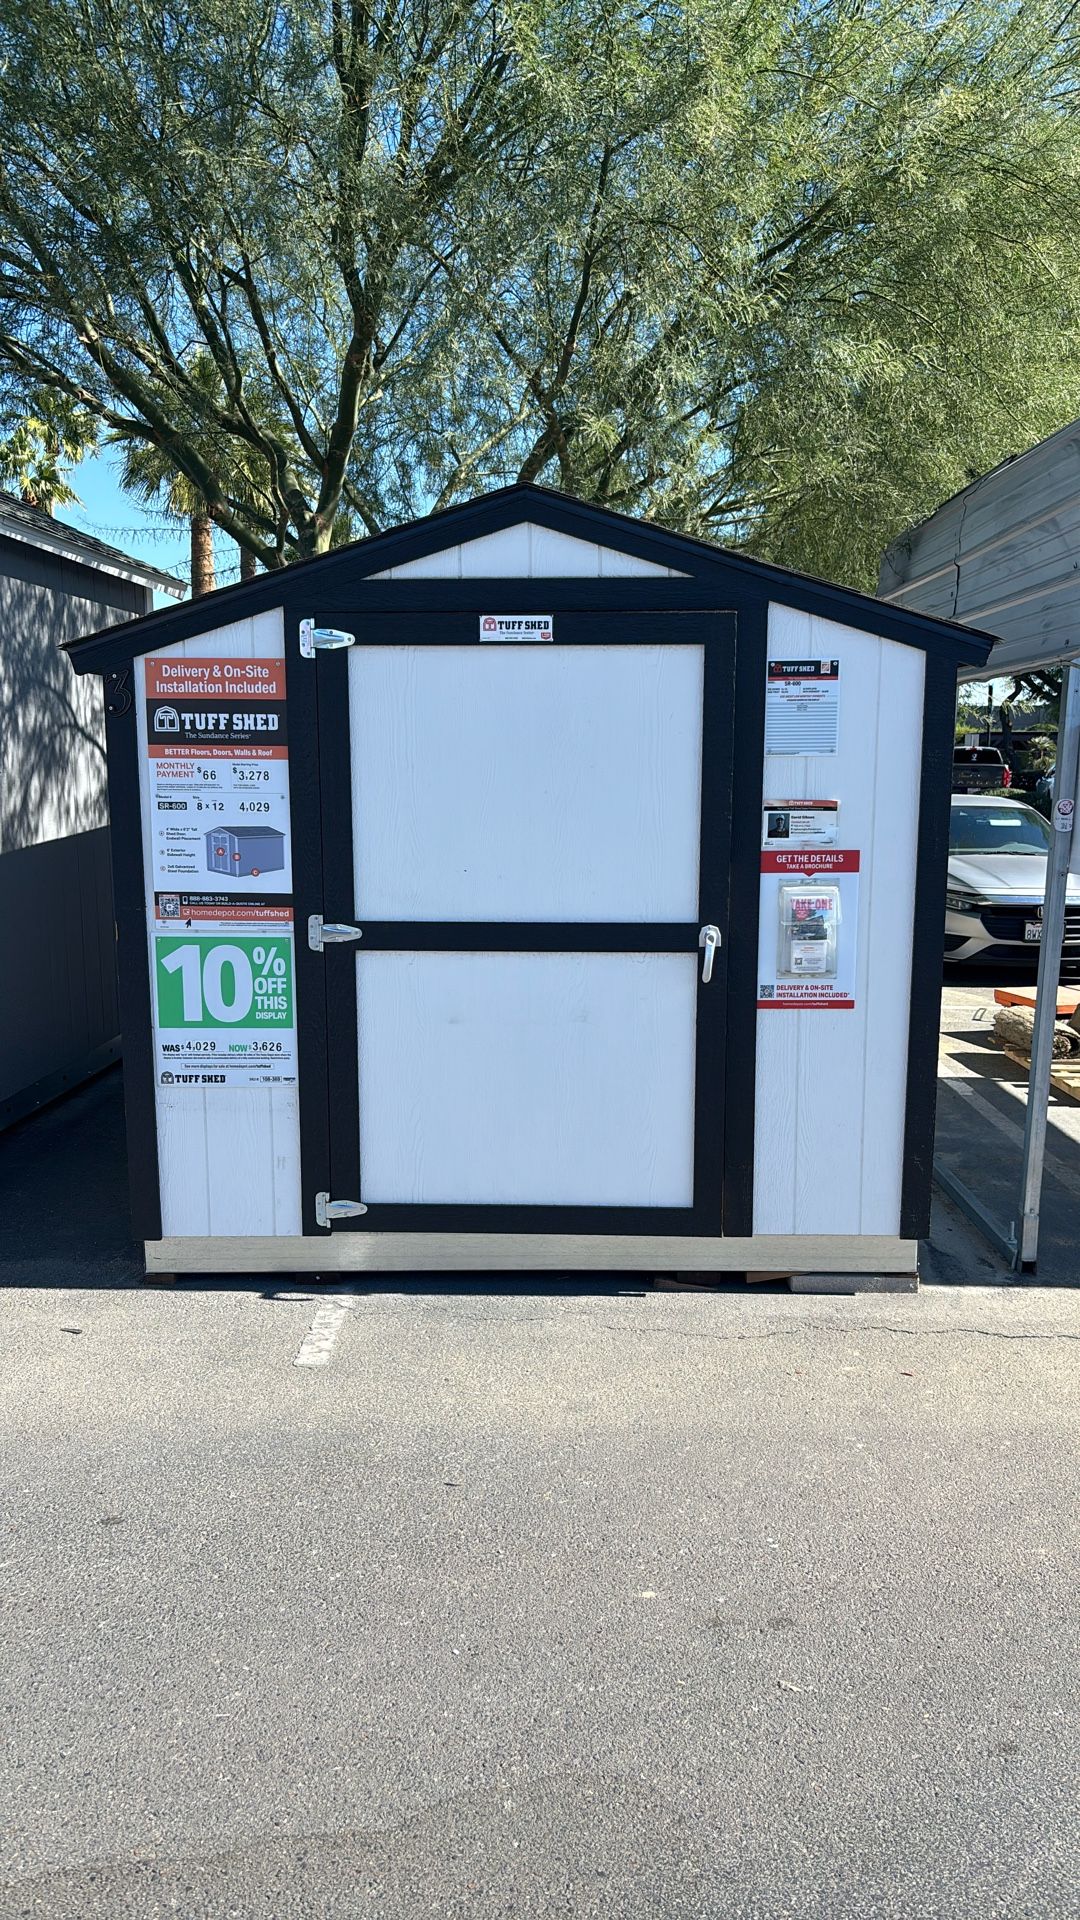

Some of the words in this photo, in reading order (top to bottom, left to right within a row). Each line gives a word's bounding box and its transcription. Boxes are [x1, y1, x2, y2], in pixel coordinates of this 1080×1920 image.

[497, 621, 524, 630] TUFF
[524, 621, 550, 630] SHED
[162, 665, 210, 680] Delivery
[213, 666, 222, 678] &
[224, 666, 270, 678] On-Site
[156, 681, 222, 693] Installation
[226, 682, 276, 694] Included
[105, 669, 132, 718] 3
[182, 713, 228, 730] TUFF
[233, 714, 279, 731] SHED
[198, 732, 229, 740] Sundance
[164, 748, 190, 756] BETTER
[156, 762, 195, 770] MONTHLY
[156, 770, 195, 778] PAYMENT
[159, 802, 186, 810] SR-600
[196, 802, 202, 810] 8
[212, 802, 224, 811] 12
[240, 802, 270, 812] 4,029
[810, 854, 844, 862] DETAILS
[192, 908, 290, 918] homedepot.com/tuffshed
[254, 978, 286, 994] OFF
[254, 996, 288, 1010] THIS
[256, 1012, 287, 1020] DISPLAY
[162, 1044, 180, 1052] WAS
[228, 1044, 248, 1052] NOW
[174, 1075, 200, 1083] TUFF
[202, 1075, 226, 1084] SHED
